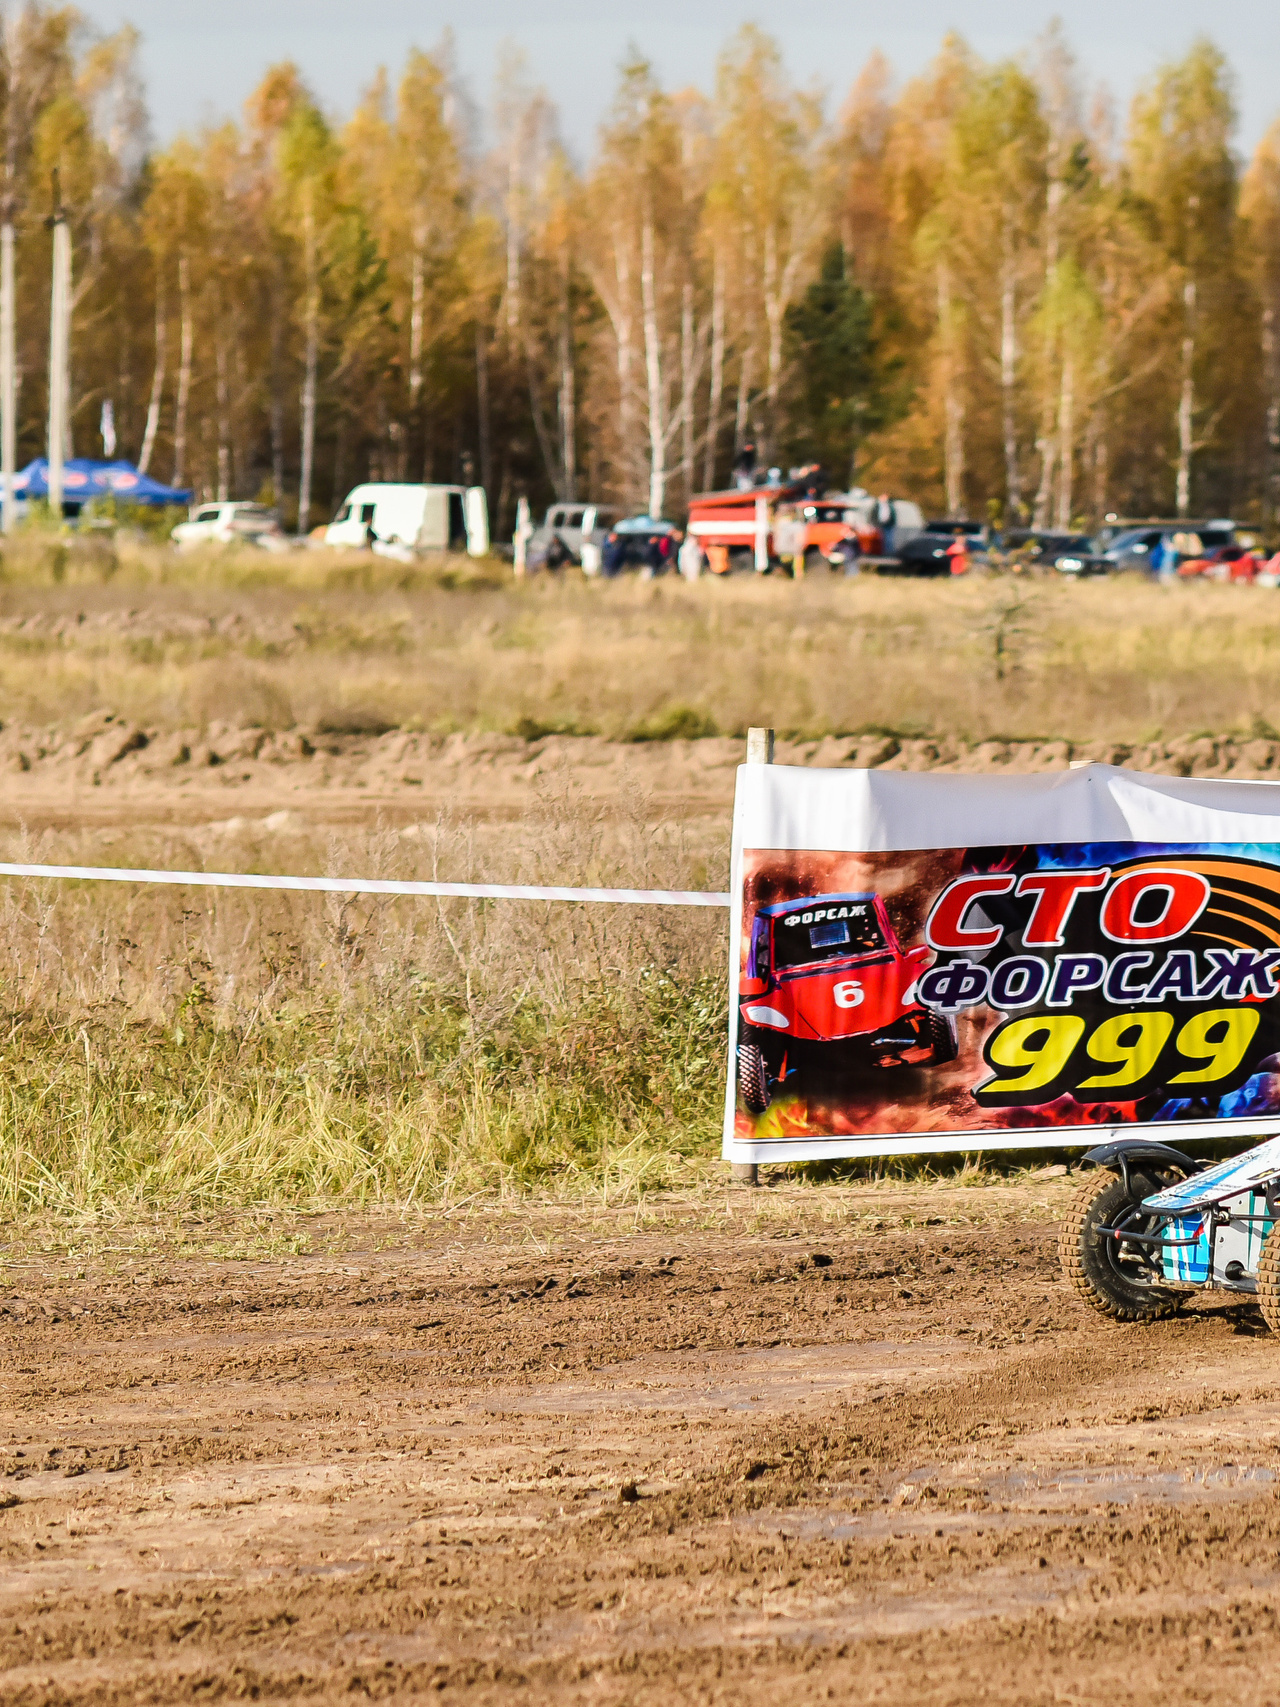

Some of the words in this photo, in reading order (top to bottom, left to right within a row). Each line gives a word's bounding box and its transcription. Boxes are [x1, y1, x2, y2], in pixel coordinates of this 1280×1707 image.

[784, 905, 867, 927] ФОРСАЖ
[925, 867, 1210, 950] СТО
[832, 980, 865, 1009] 6
[978, 1007, 1261, 1094] 999
